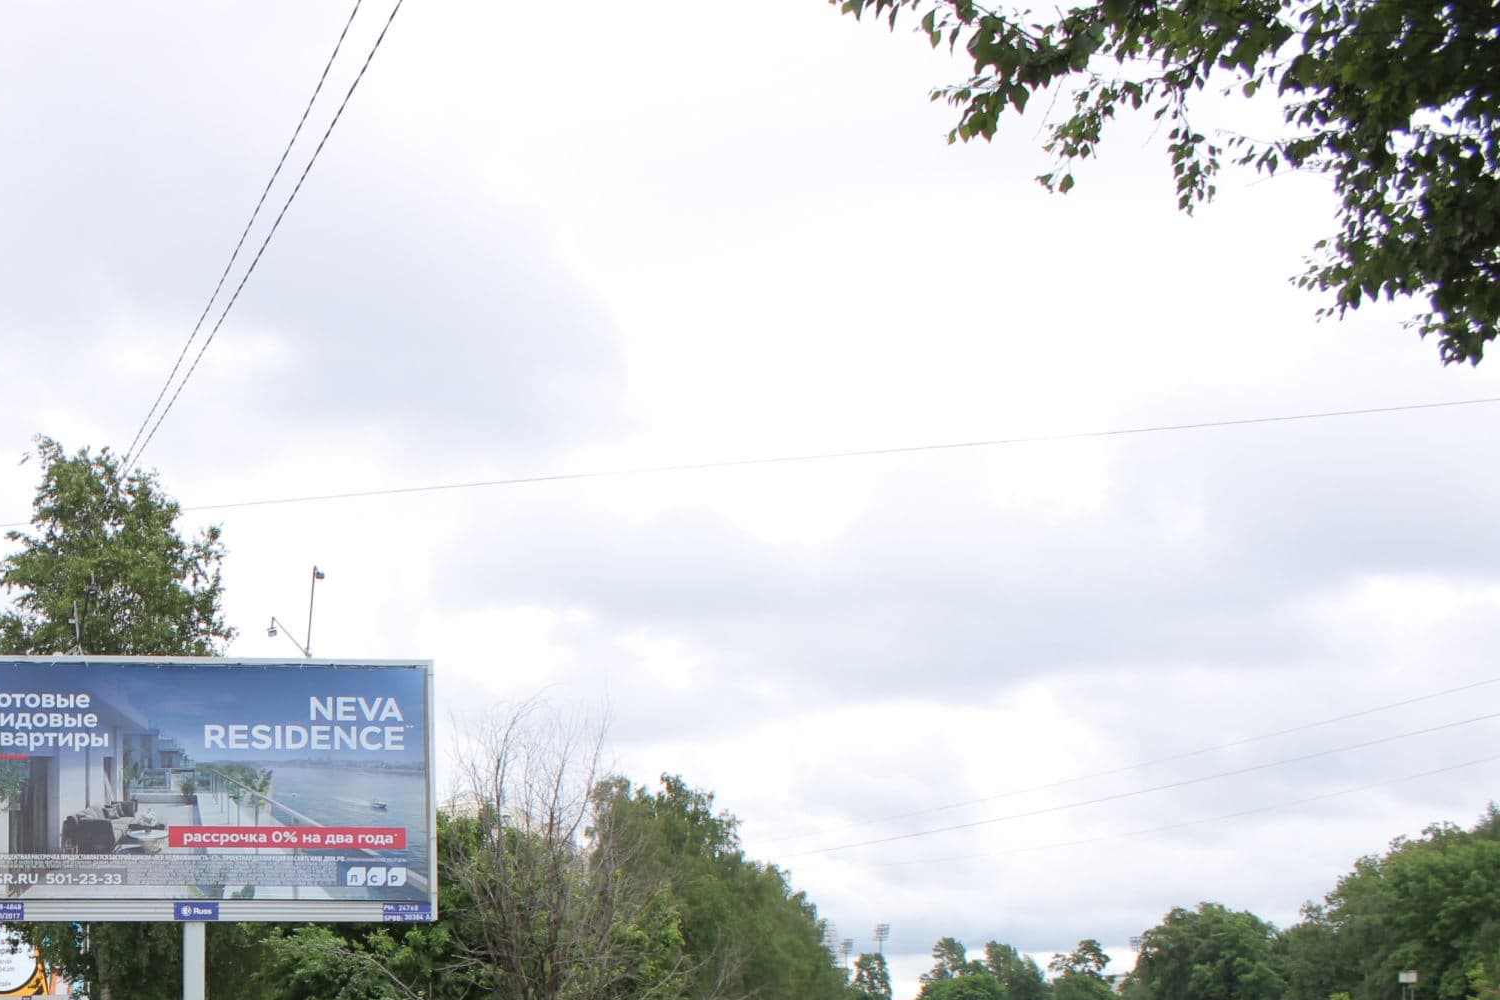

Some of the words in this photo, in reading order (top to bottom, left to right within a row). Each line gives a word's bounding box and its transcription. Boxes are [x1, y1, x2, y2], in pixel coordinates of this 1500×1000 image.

[310, 696, 404, 721] NEVA
[183, 832, 267, 845] рассрочка
[272, 831, 298, 843] 0%
[302, 833, 321, 844] на
[325, 833, 353, 845] два
[46, 873, 122, 884] 501-23-33
[193, 907, 212, 915] Russ
